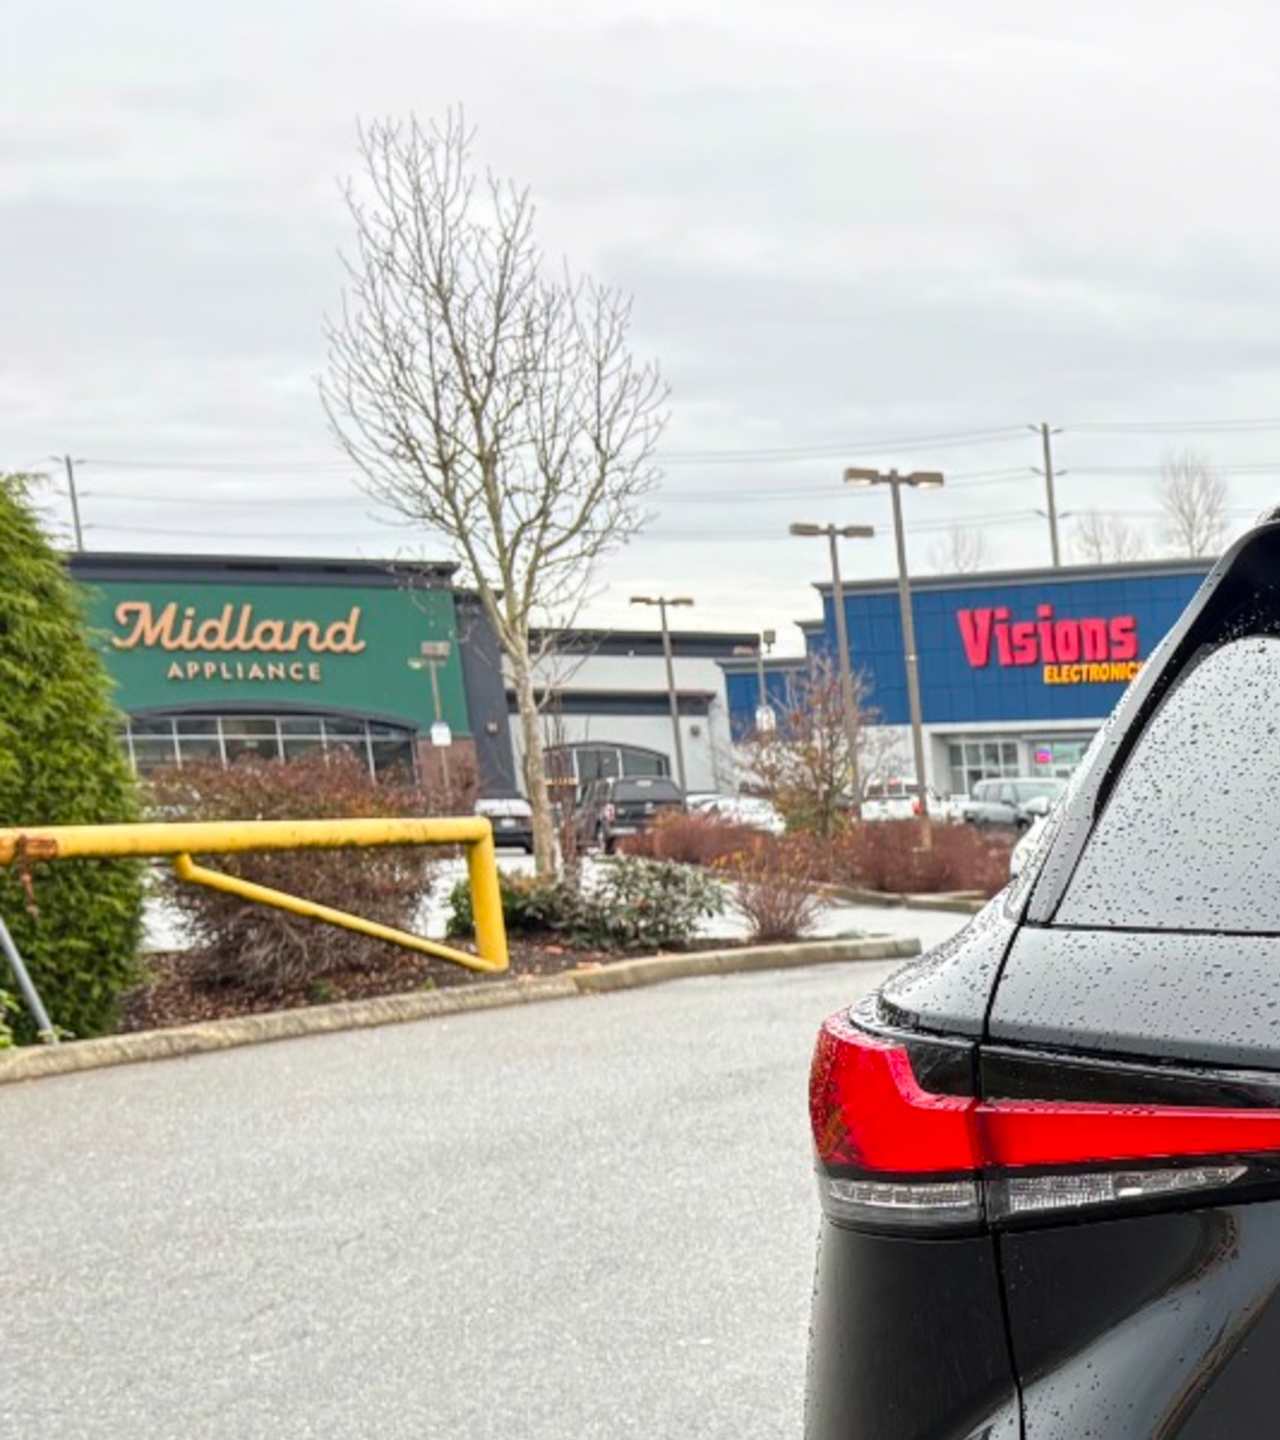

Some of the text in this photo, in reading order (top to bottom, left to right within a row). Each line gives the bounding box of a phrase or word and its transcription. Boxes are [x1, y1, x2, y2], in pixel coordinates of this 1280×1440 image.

[112, 601, 366, 652] Midland
[957, 604, 1137, 668] Visions
[167, 661, 321, 681] APPLIANCE
